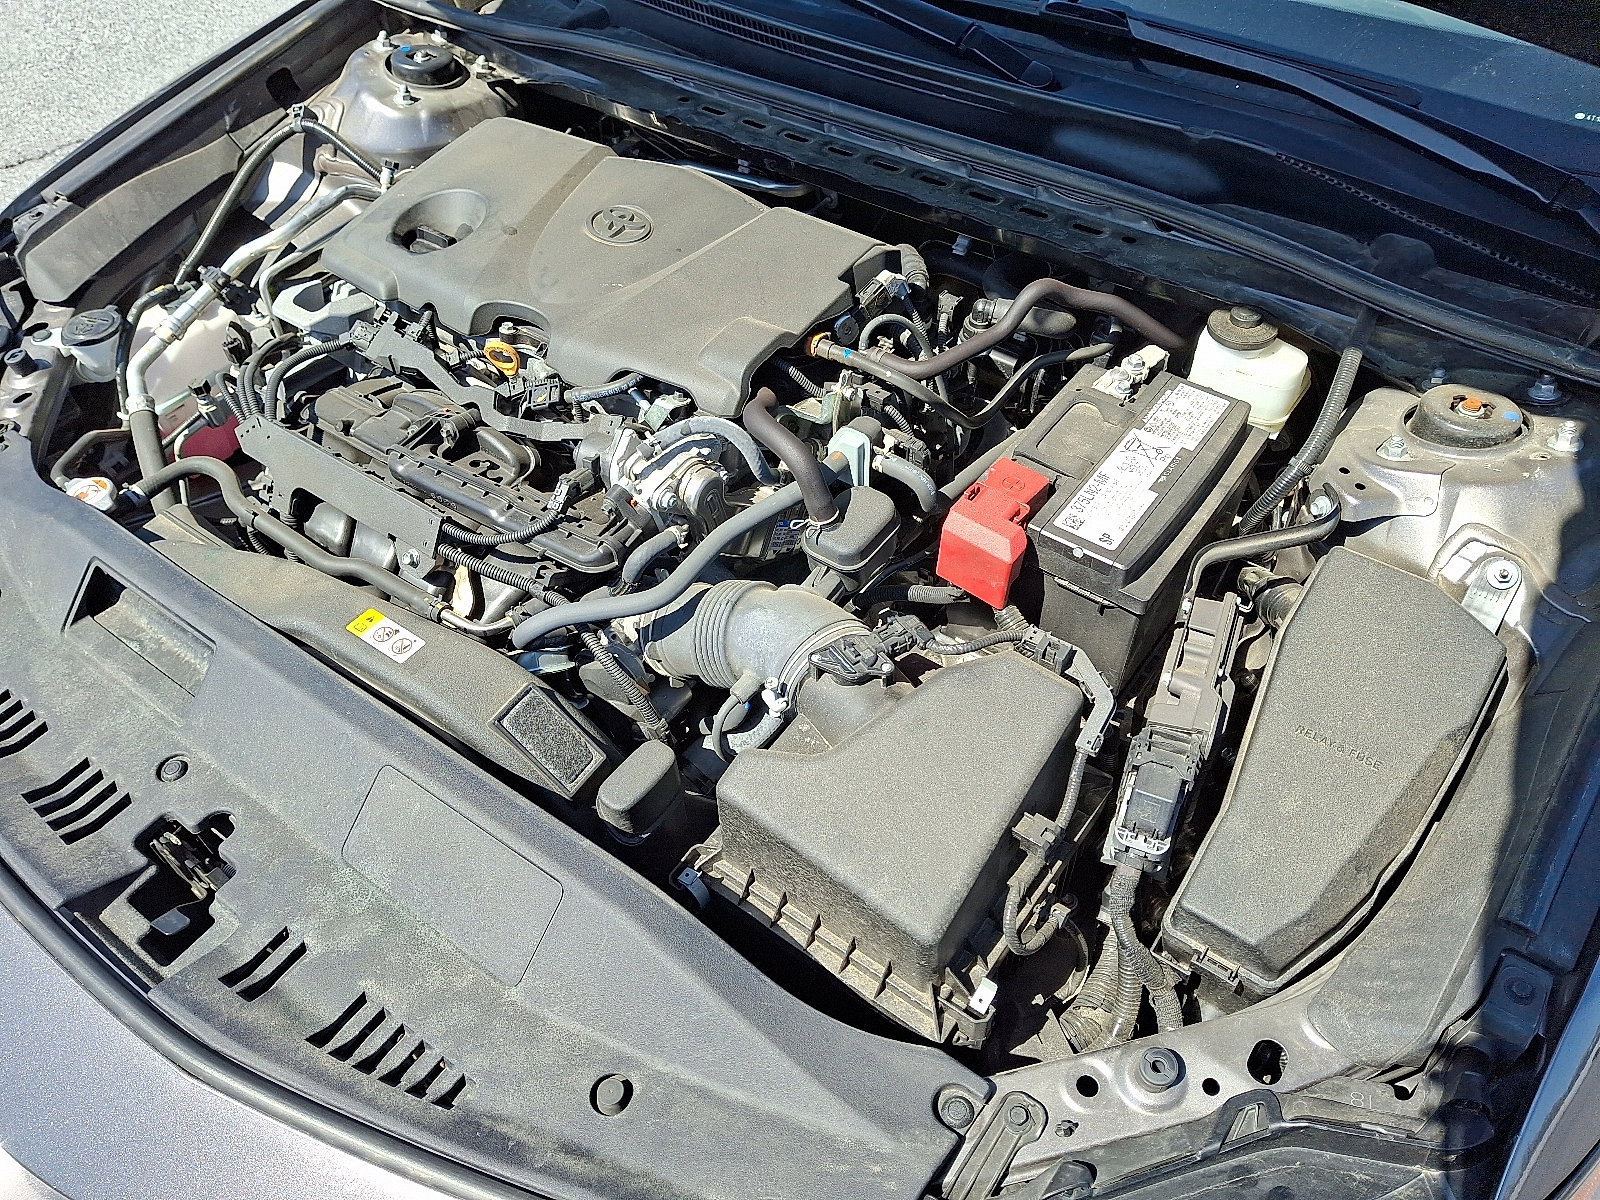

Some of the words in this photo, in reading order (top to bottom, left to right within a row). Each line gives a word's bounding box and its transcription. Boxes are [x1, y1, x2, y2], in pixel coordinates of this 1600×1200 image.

[1070, 470, 1110, 513] 375LN2-MF
[1099, 532, 1115, 546] SP
[1295, 724, 1336, 748] RELAY
[1349, 748, 1382, 771] FUSE
